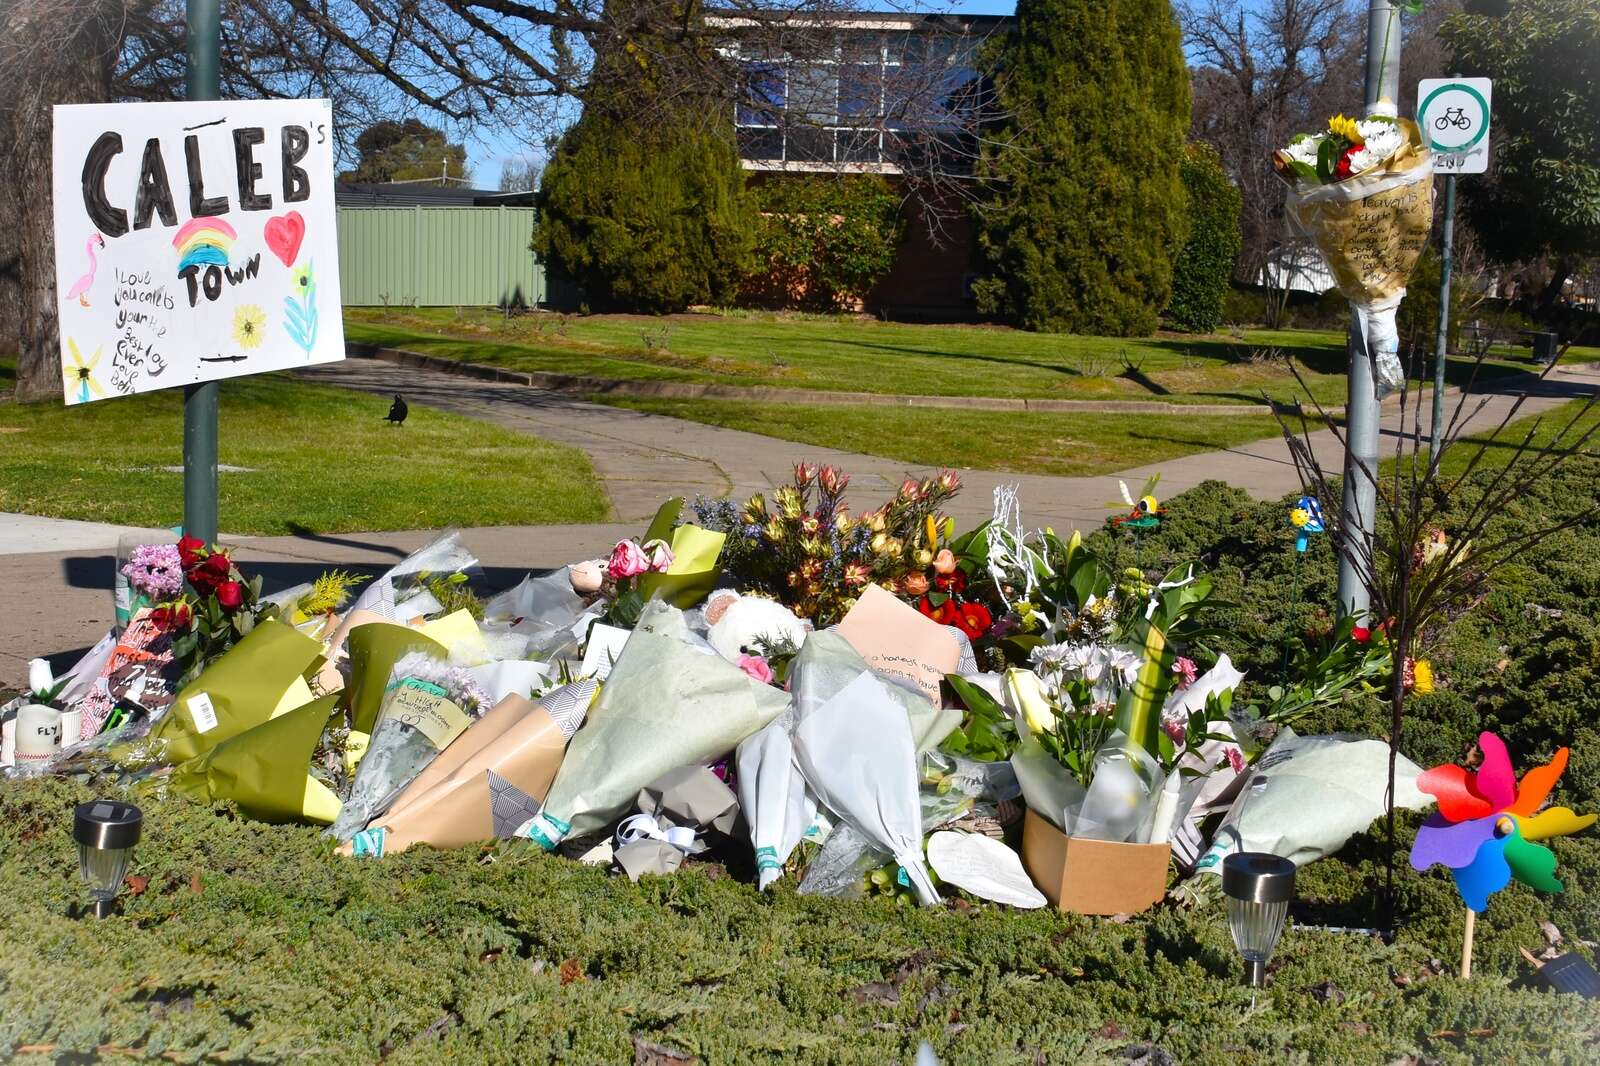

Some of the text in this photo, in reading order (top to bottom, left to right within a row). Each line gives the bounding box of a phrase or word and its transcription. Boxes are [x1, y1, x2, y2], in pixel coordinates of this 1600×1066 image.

[1437, 154, 1465, 167] END
[178, 253, 261, 308] TOWN
[37, 725, 58, 736] FLY
